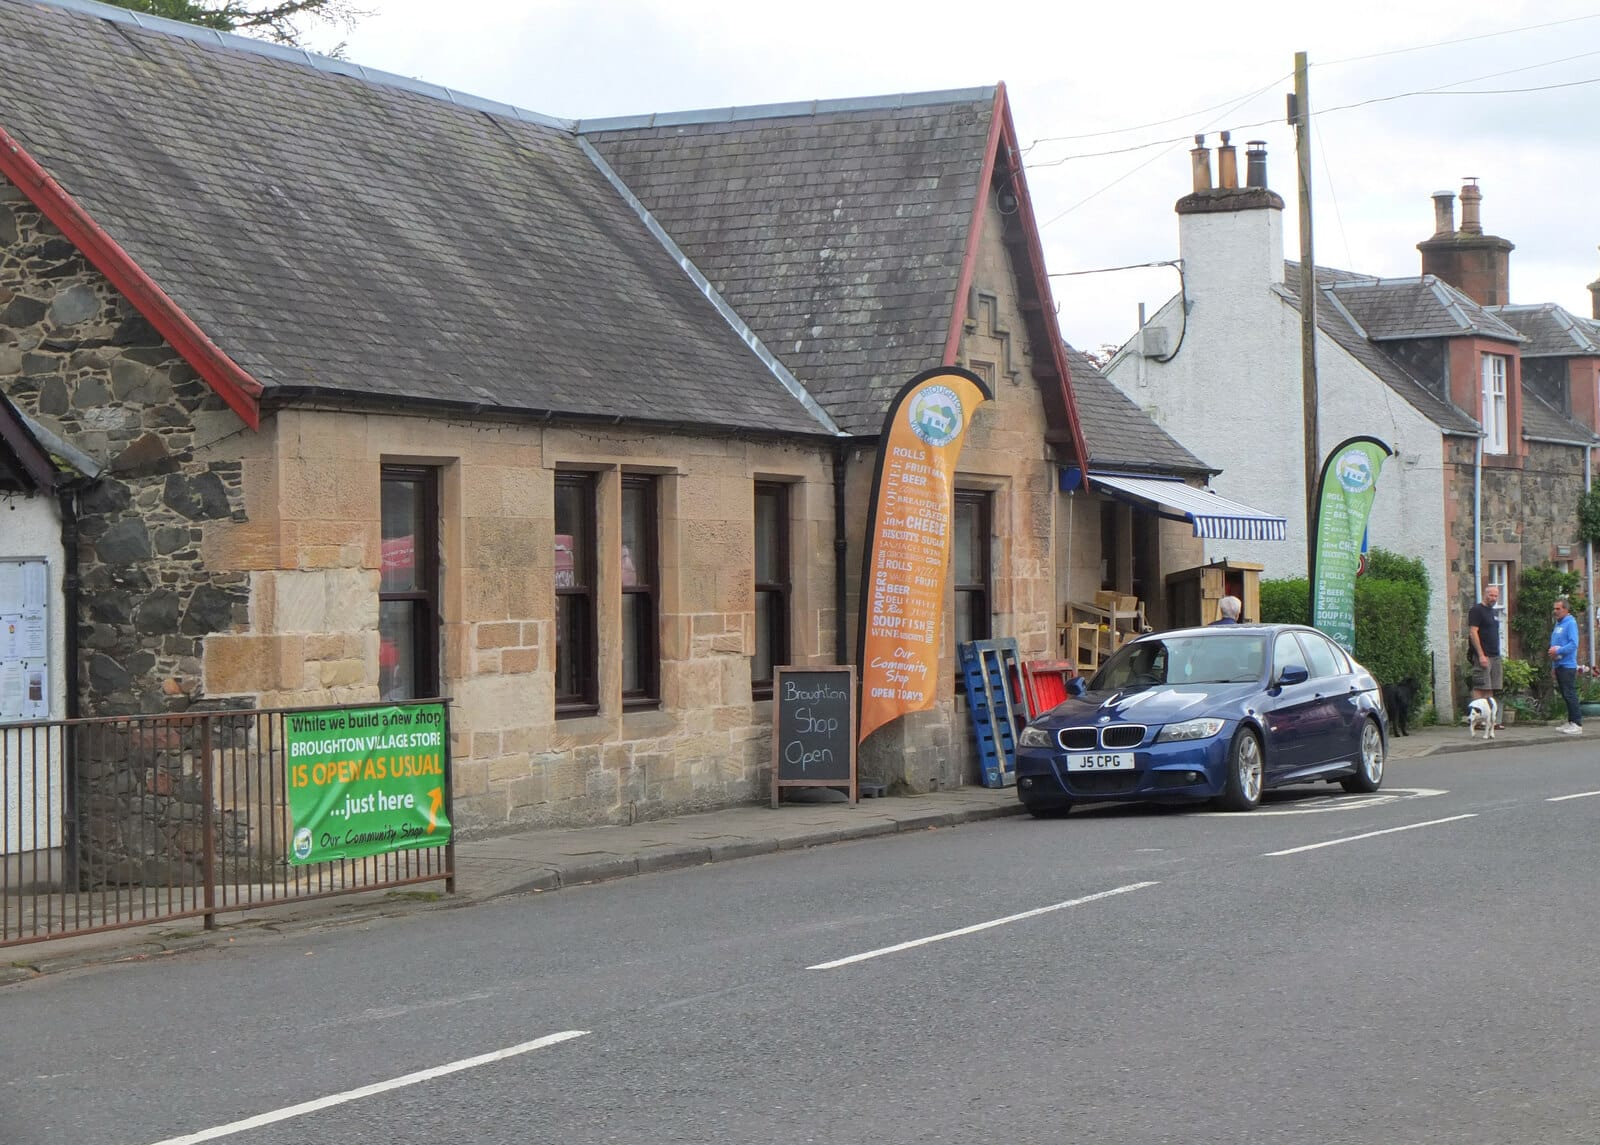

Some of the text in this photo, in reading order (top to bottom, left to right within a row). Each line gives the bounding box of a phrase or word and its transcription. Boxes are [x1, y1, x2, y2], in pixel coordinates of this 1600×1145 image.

[893, 447, 926, 460] ROLLS
[904, 462, 932, 475] FRUIT
[902, 473, 927, 486] BEER
[897, 495, 926, 507] BREAD
[883, 515, 946, 536] JAM CHEESE
[881, 528, 945, 548] BISCUITS SUGAR
[885, 559, 913, 571] ROLLS
[886, 583, 910, 594] BEER
[914, 575, 938, 588] FRUIT
[873, 571, 888, 613] PAPERS
[1326, 588, 1345, 597] BEER
[873, 615, 926, 631] SOUP FISH
[1317, 611, 1339, 620] SOUP
[871, 627, 900, 639] WINE
[894, 647, 915, 659] Our
[870, 656, 928, 681] Community
[885, 669, 909, 689] Shop
[784, 681, 847, 705] Broughton
[871, 687, 895, 699] OPEN
[292, 709, 442, 733] While we build a new shop
[794, 707, 838, 739] Shop
[291, 732, 441, 757] BROUGHTON VILLAGE STORE
[784, 740, 834, 772] Open
[1080, 755, 1121, 768] J5 CPG
[291, 752, 443, 788] IS OPEN AS USUAL
[378, 790, 414, 811] here
[320, 832, 341, 848] Our
[345, 825, 397, 845] Community
[400, 822, 424, 842] Shop
